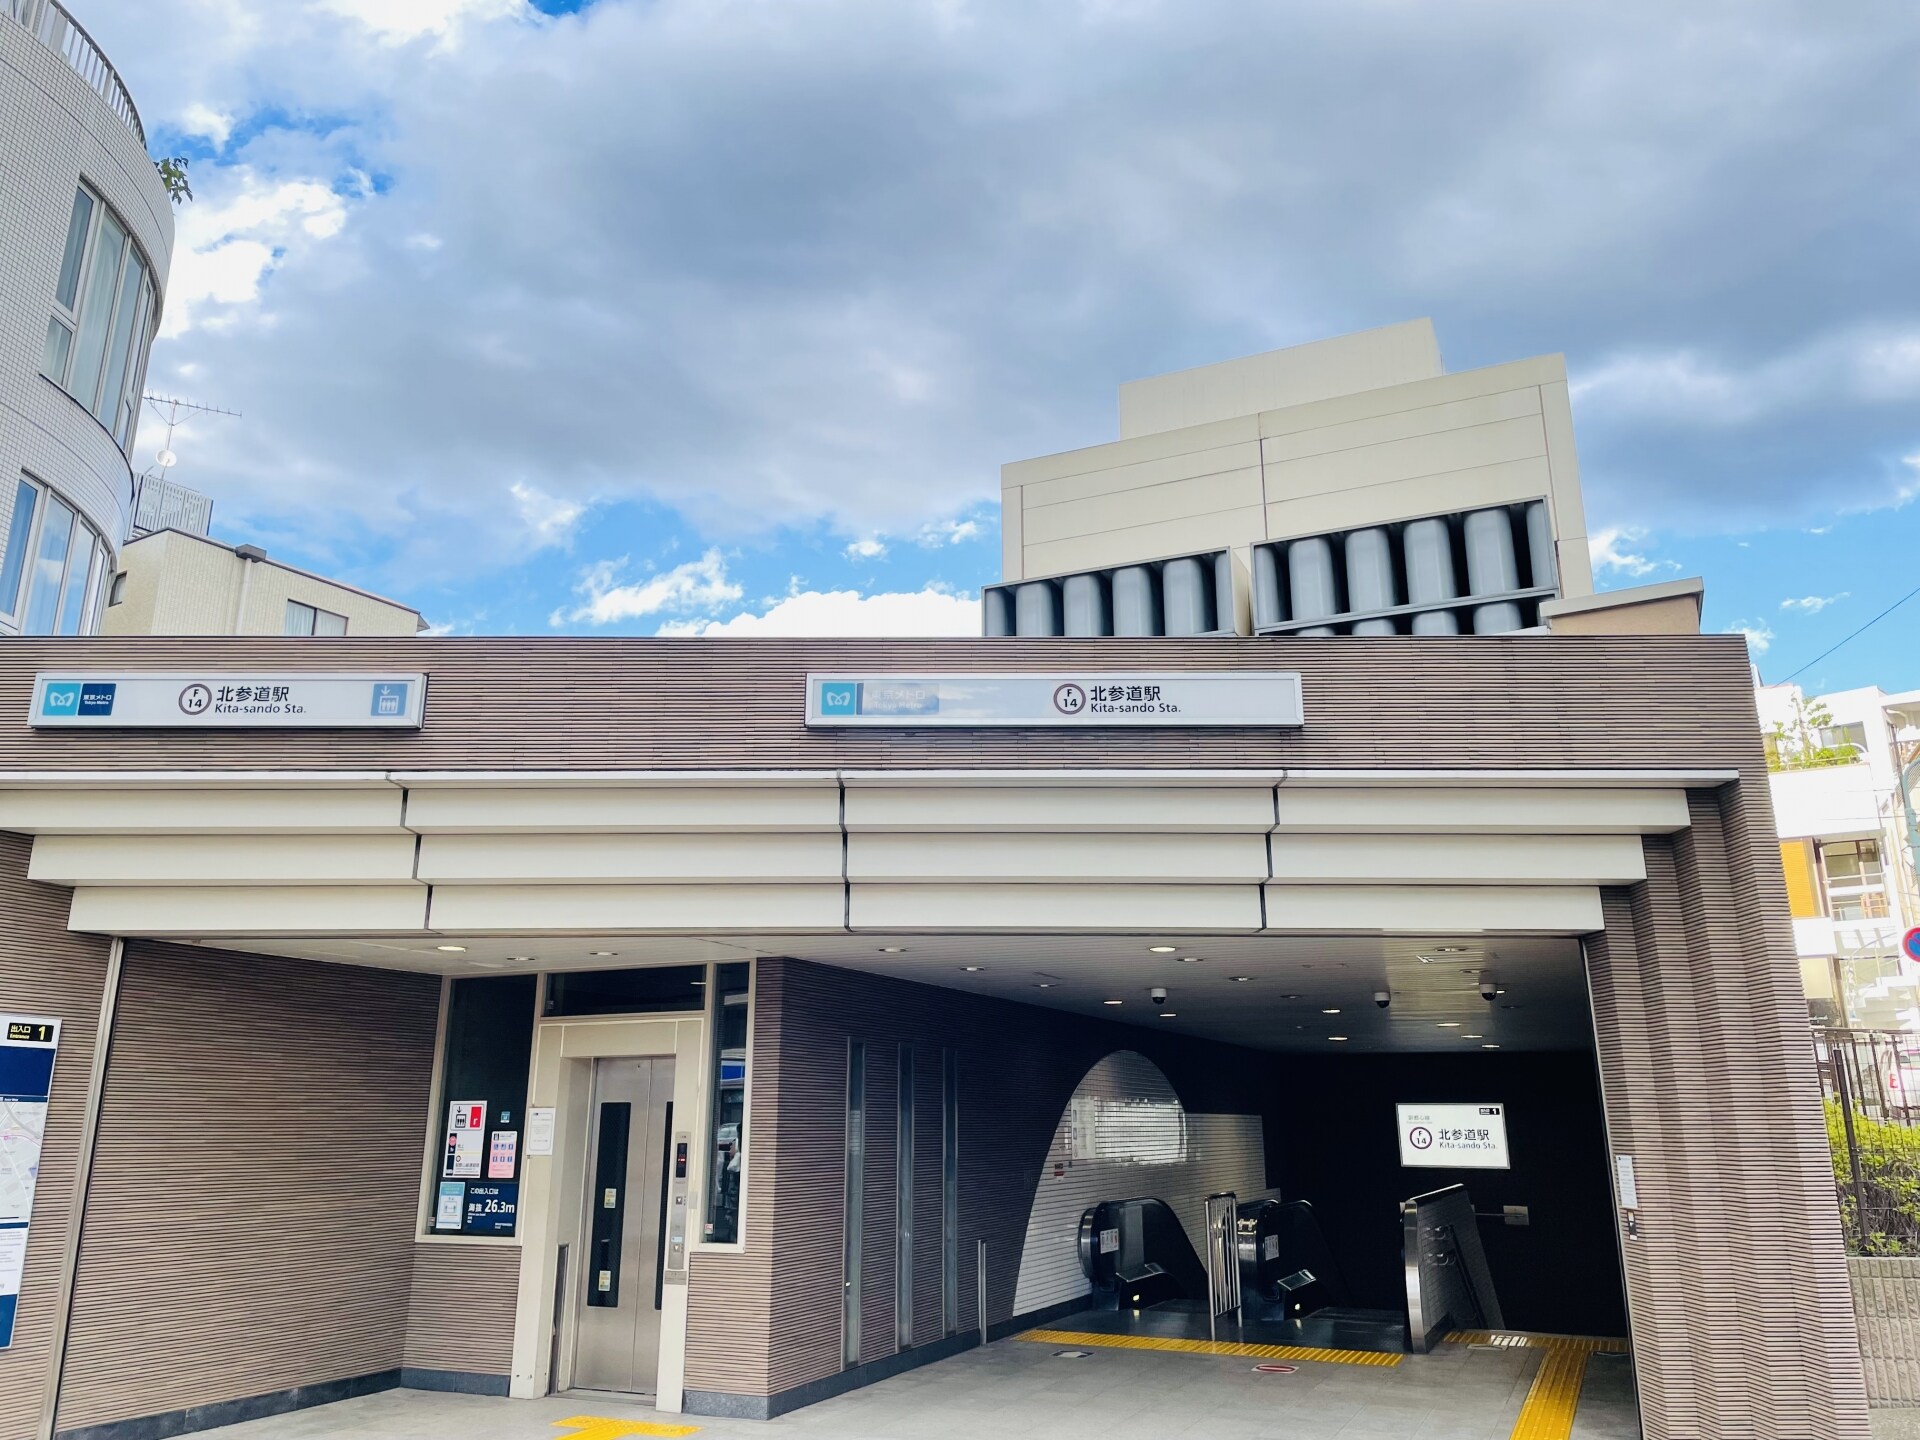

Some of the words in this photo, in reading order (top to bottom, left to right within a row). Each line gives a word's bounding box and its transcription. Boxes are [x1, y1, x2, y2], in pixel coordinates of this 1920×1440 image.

[193, 688, 199, 697] F
[216, 686, 290, 702] 北参道駅
[1067, 688, 1073, 697] F
[1090, 685, 1161, 702] 北参道駅
[188, 698, 202, 708] 14
[1063, 698, 1078, 708] 14
[1091, 703, 1155, 713] Kita-sando
[1159, 703, 1181, 713] Sta.
[215, 703, 280, 714] Kita-sando
[284, 703, 306, 714] Sta.
[11, 1024, 31, 1033] 出入口
[38, 1025, 46, 1041] 1
[1439, 1128, 1490, 1141] 北参道駅
[1416, 1137, 1427, 1145] 14
[1439, 1141, 1481, 1149] Kita-sando
[484, 1199, 515, 1213] 26.3m
